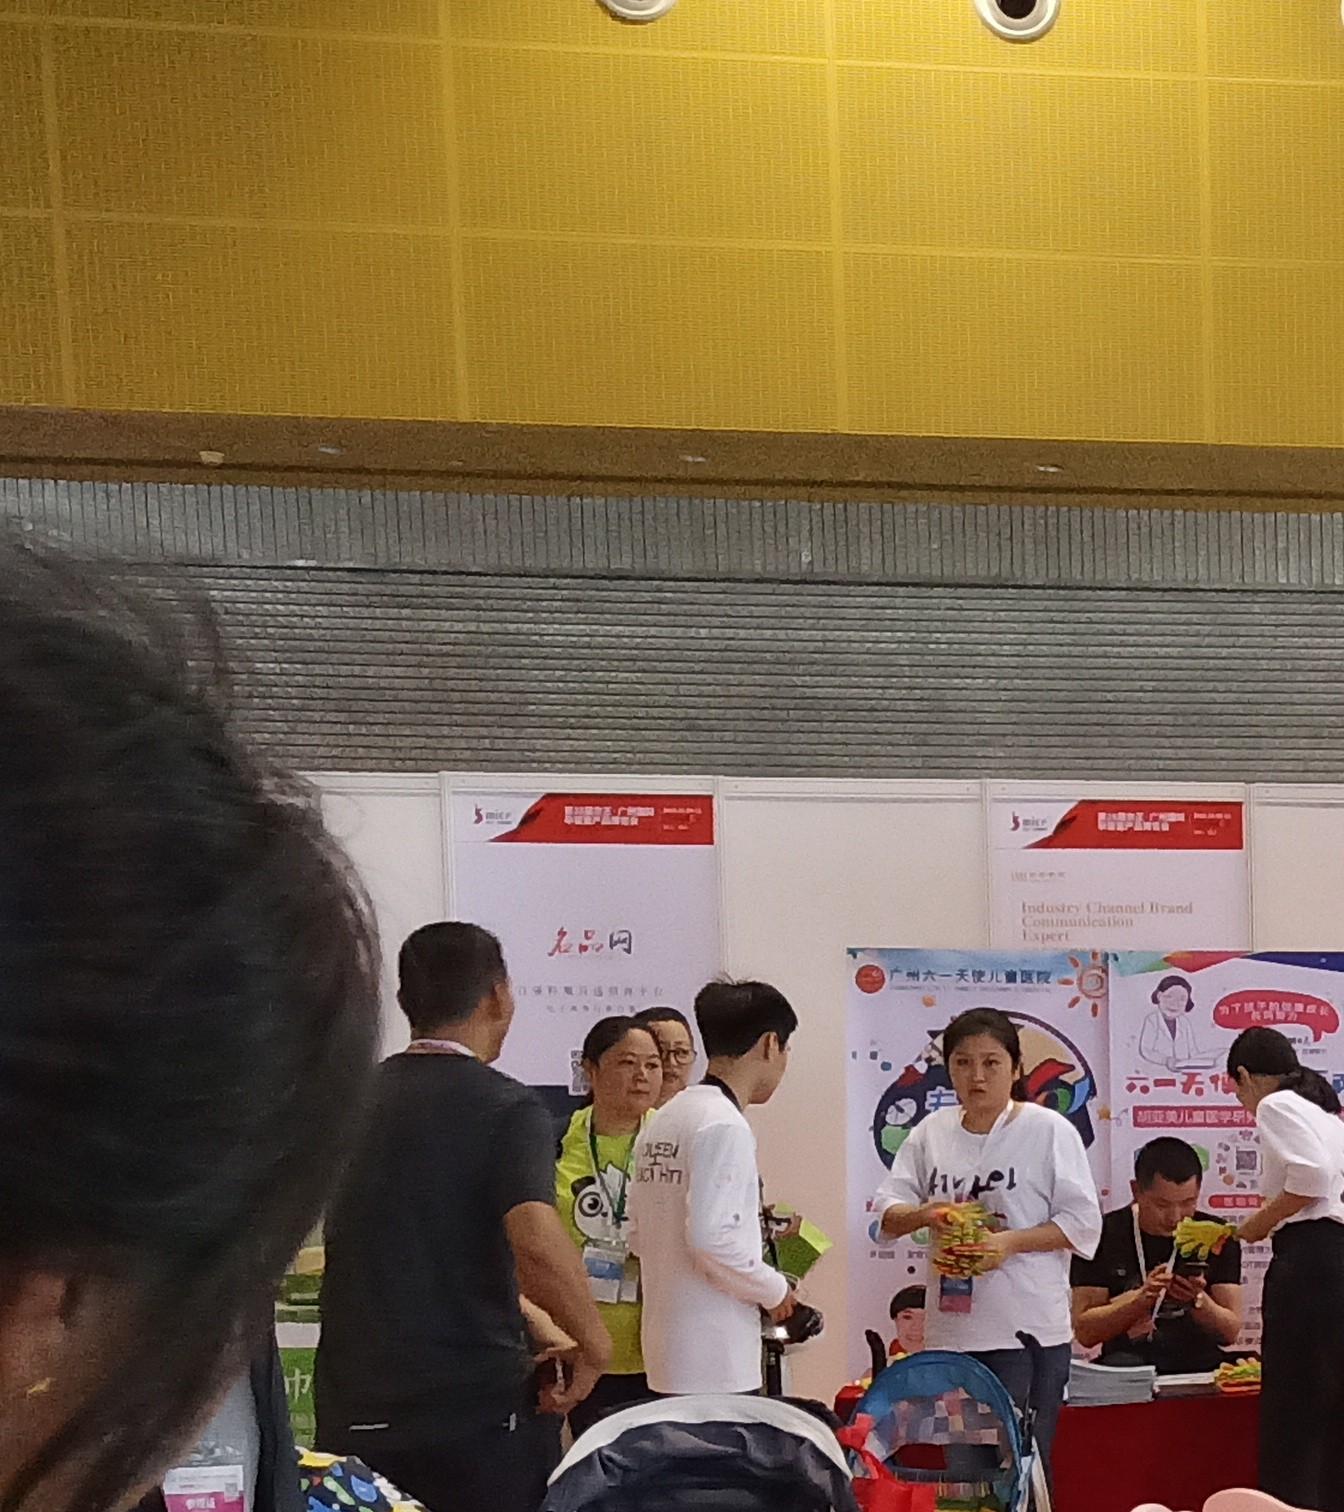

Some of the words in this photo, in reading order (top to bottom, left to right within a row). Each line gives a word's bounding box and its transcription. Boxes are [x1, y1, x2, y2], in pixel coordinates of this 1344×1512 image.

[1021, 901, 1081, 914] Industry
[1086, 901, 1145, 914] Channel
[1149, 901, 1193, 914] Brand
[1021, 915, 1134, 927] Communication
[1022, 930, 1071, 943] Expert
